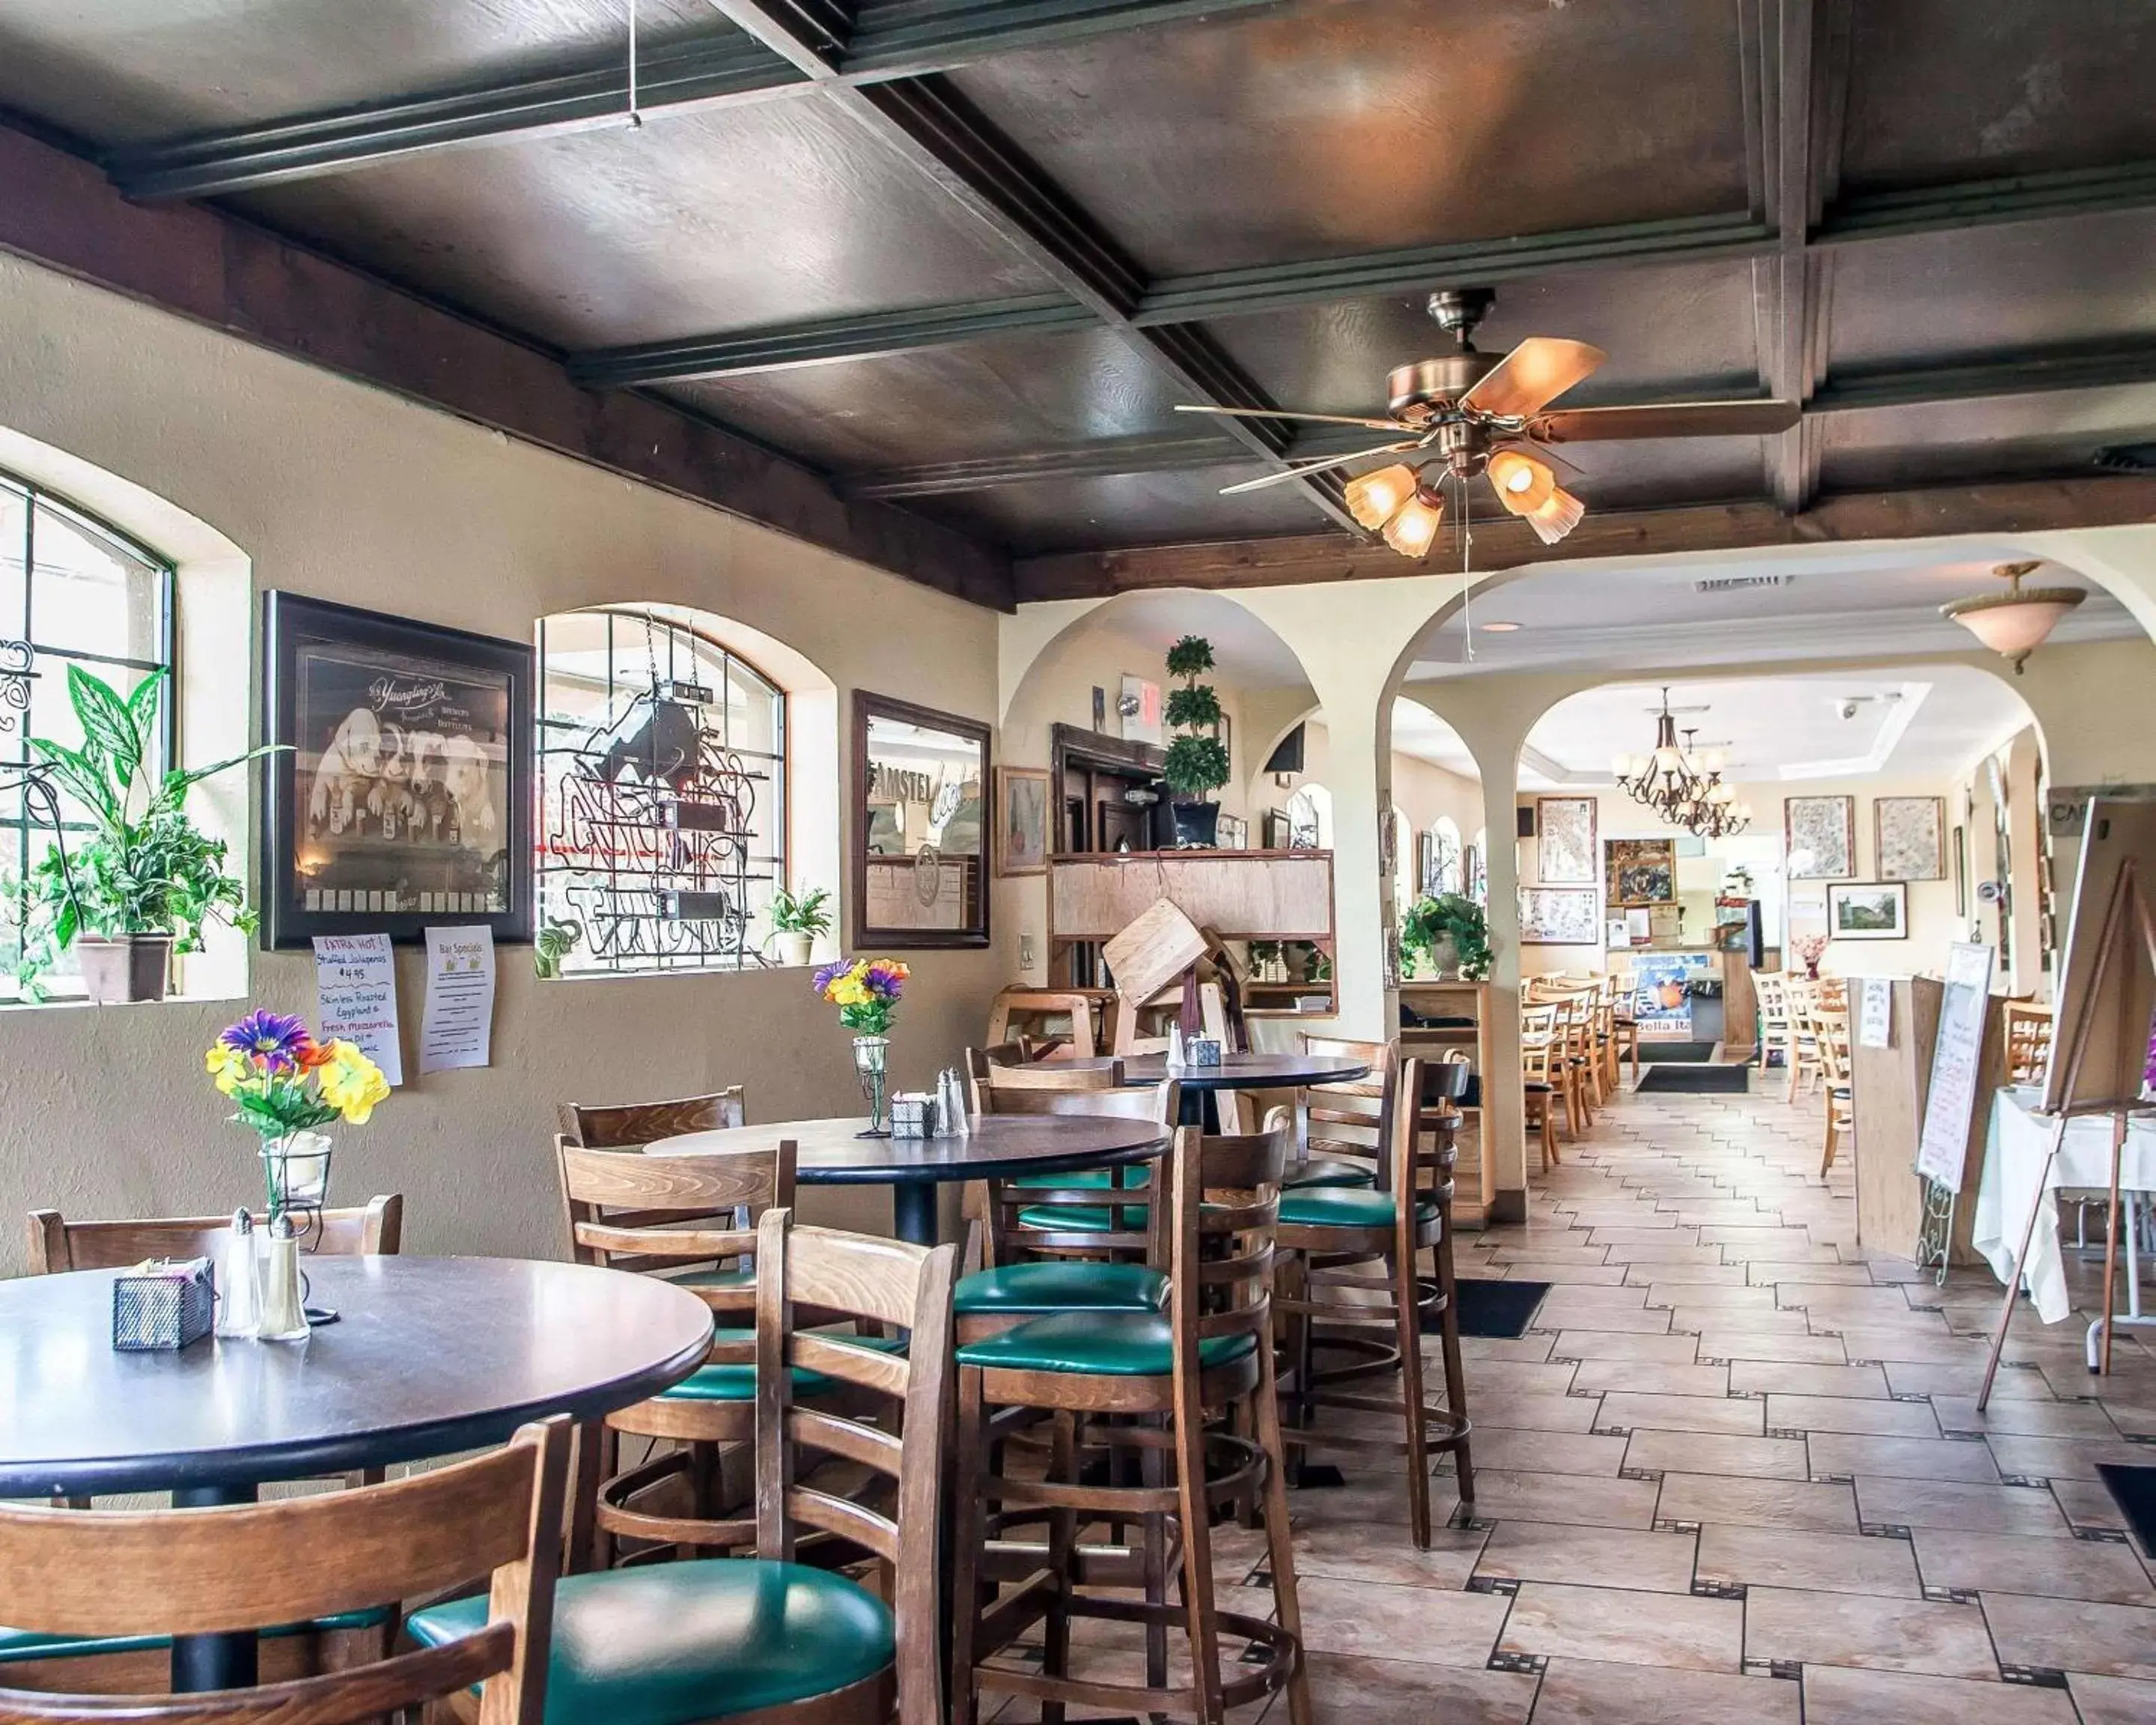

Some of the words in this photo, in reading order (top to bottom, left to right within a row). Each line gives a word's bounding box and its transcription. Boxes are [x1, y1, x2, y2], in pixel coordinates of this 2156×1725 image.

[874, 761, 933, 802] AMSTEL
[324, 939, 355, 951] EXTRA
[355, 991, 386, 1002] Roasted
[322, 1020, 345, 1032] Fresh
